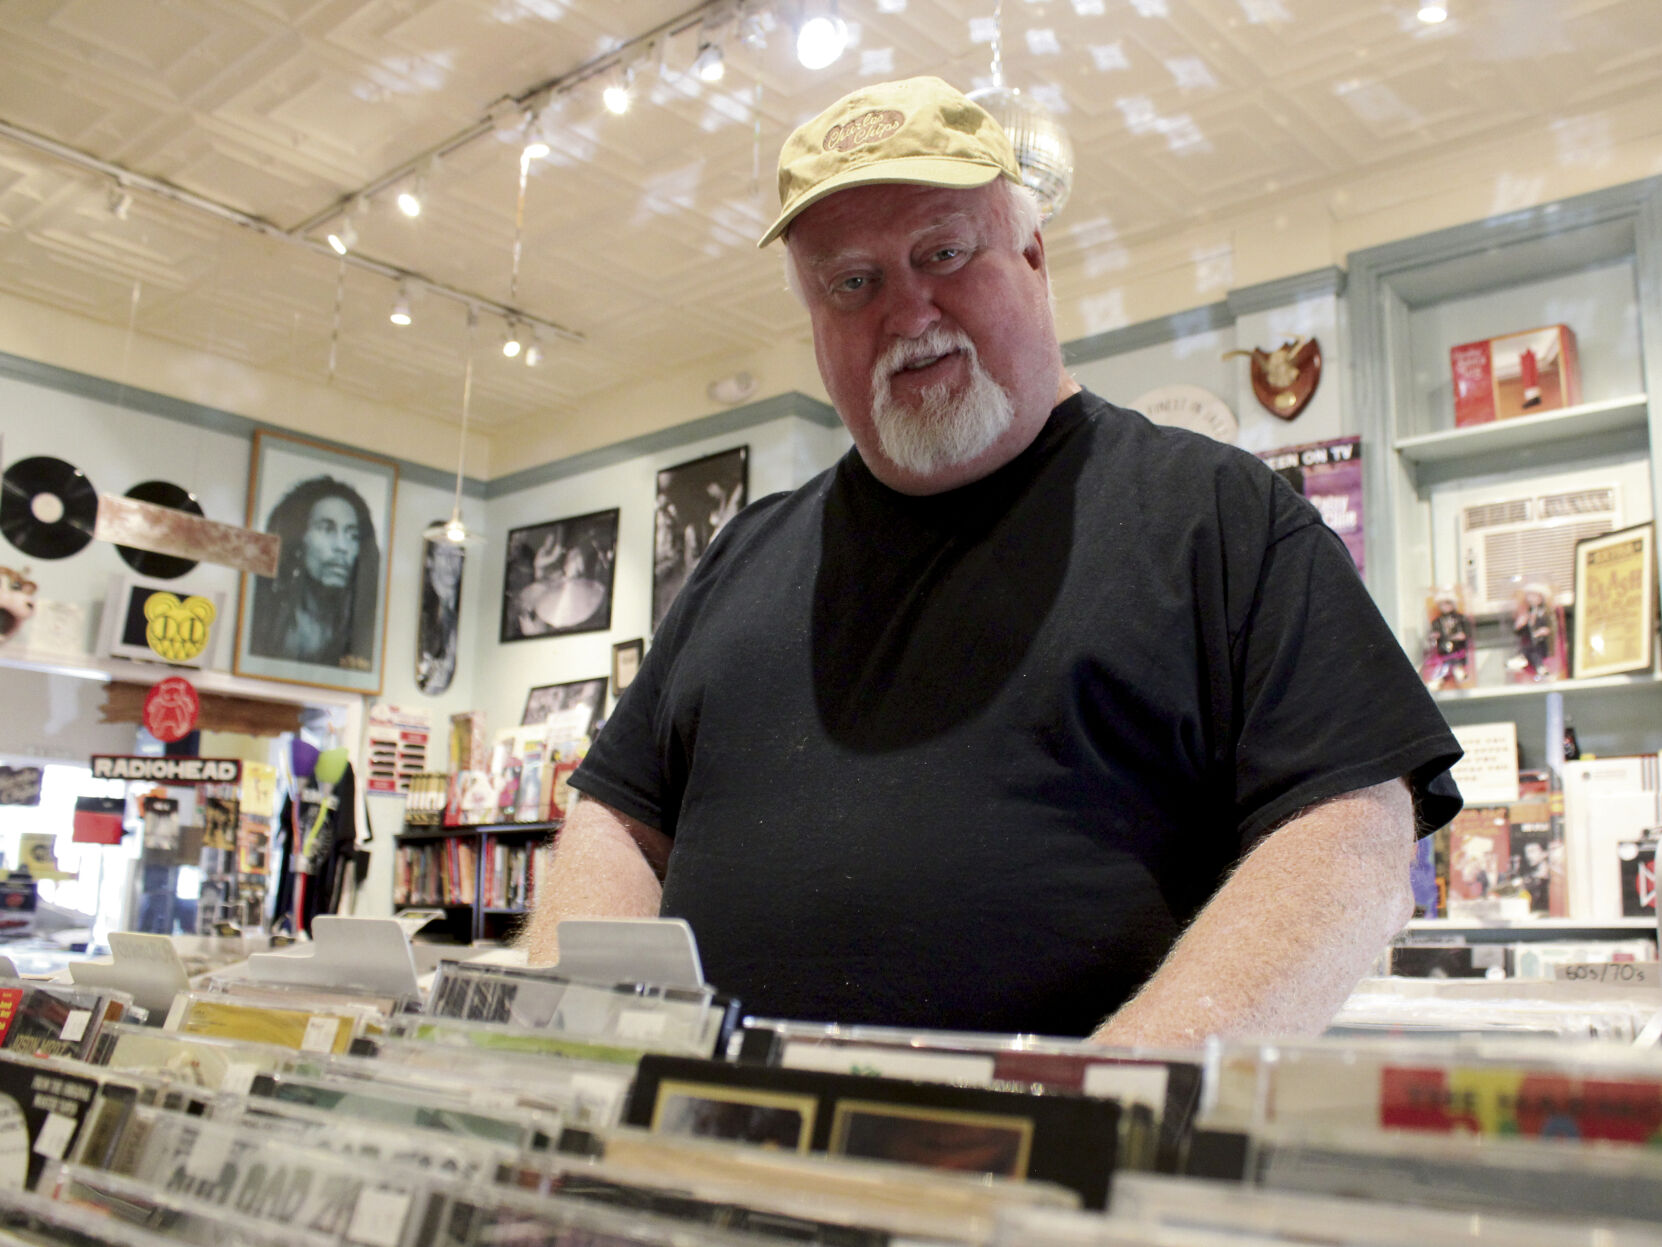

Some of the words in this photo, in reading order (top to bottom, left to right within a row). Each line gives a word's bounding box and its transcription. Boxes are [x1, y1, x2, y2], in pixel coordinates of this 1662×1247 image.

[854, 120, 900, 144] Chips
[1301, 448, 1328, 466] ON
[1330, 443, 1354, 462] TV
[95, 757, 237, 780] RADIOHEAD
